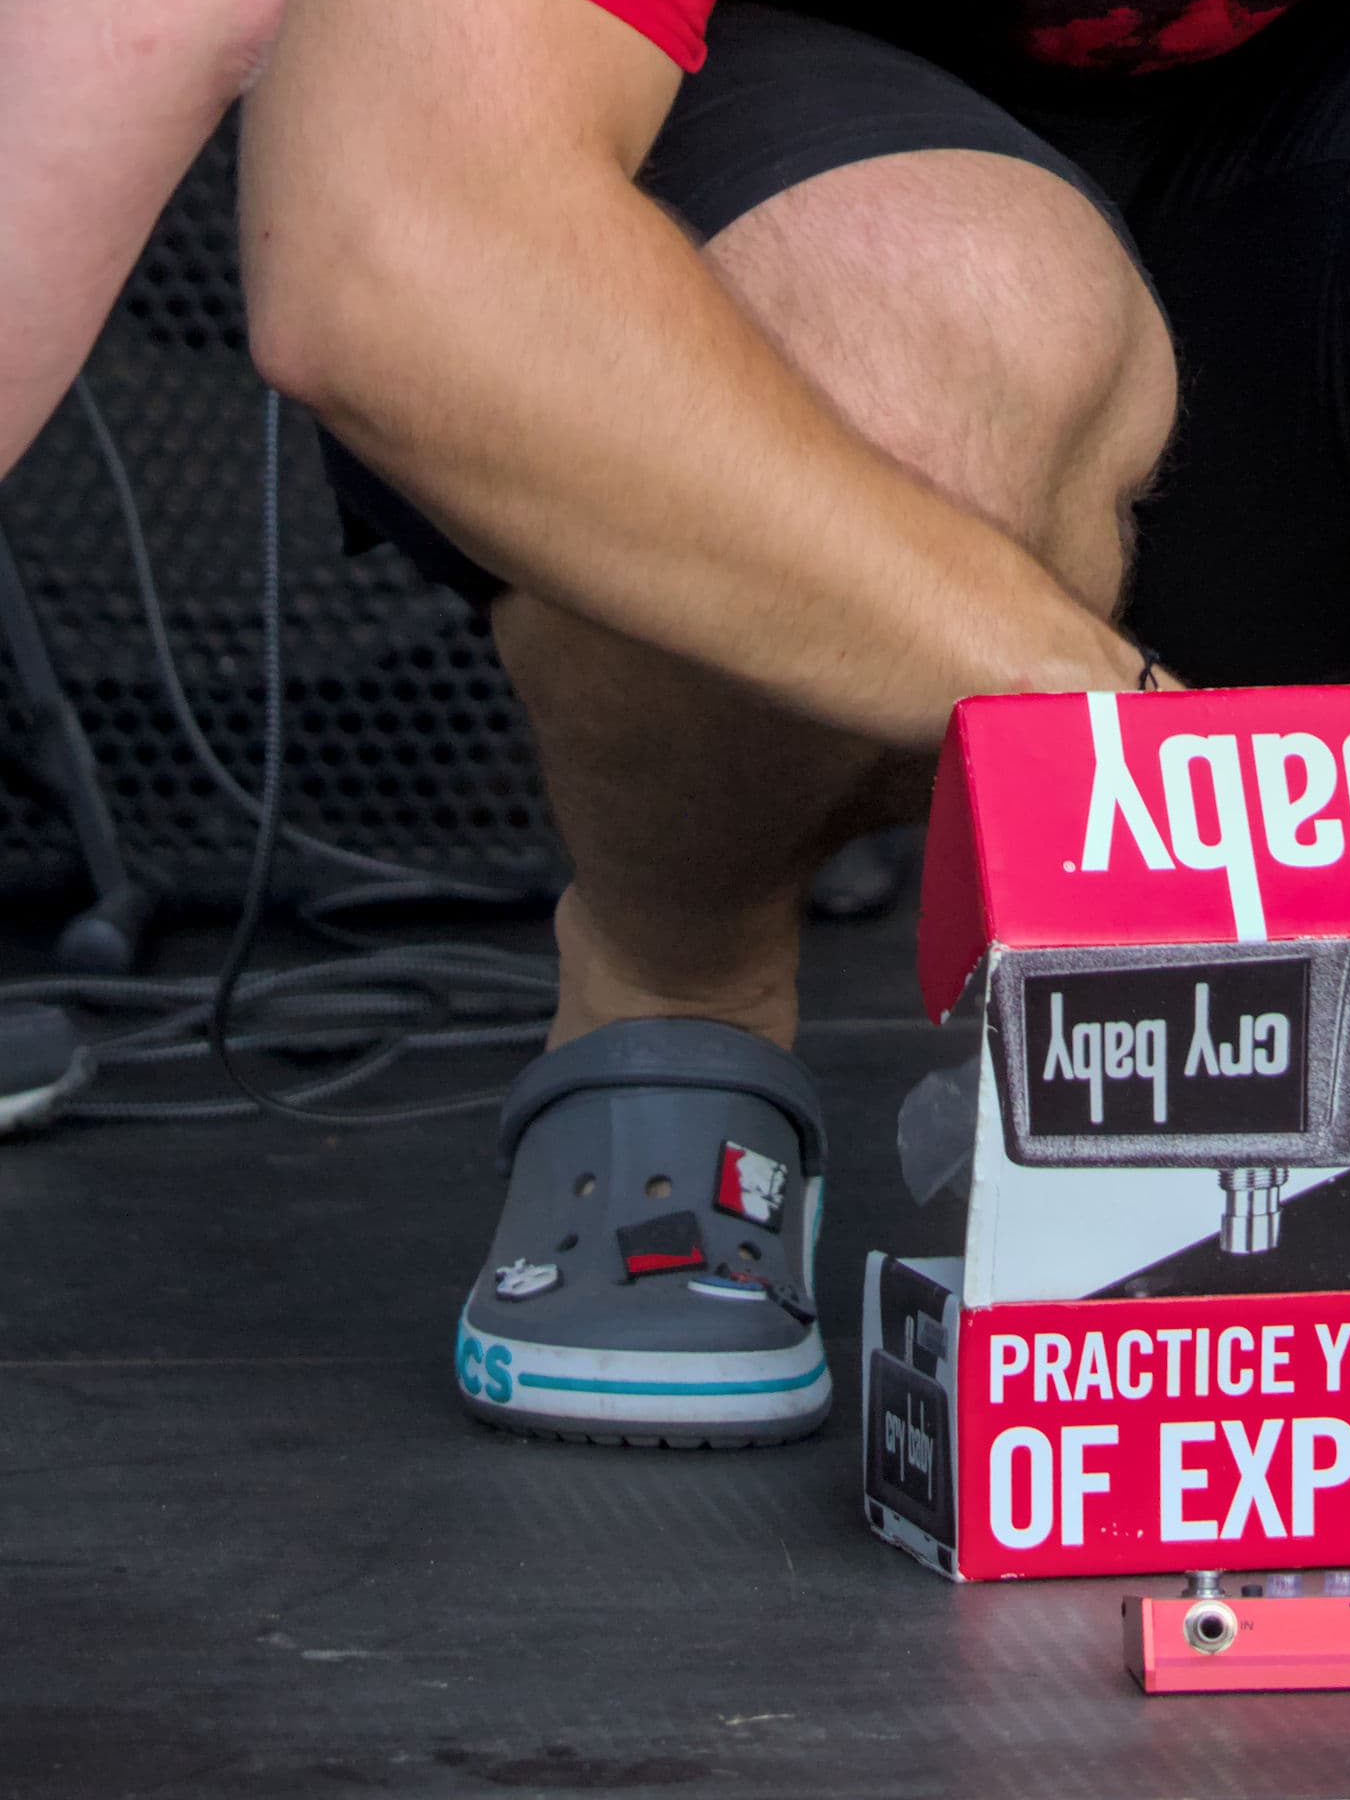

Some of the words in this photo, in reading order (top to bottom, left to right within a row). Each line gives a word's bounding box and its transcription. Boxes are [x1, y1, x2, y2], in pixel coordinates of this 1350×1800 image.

[1042, 991, 1168, 1124] baby
[1183, 982, 1291, 1077] cry
[456, 1320, 513, 1404] CS
[989, 1324, 1296, 1404] PRACTICE
[885, 1410, 905, 1482] cry
[907, 1392, 934, 1501] baby
[988, 1424, 1121, 1549] OF
[1240, 1620, 1254, 1631] IN
